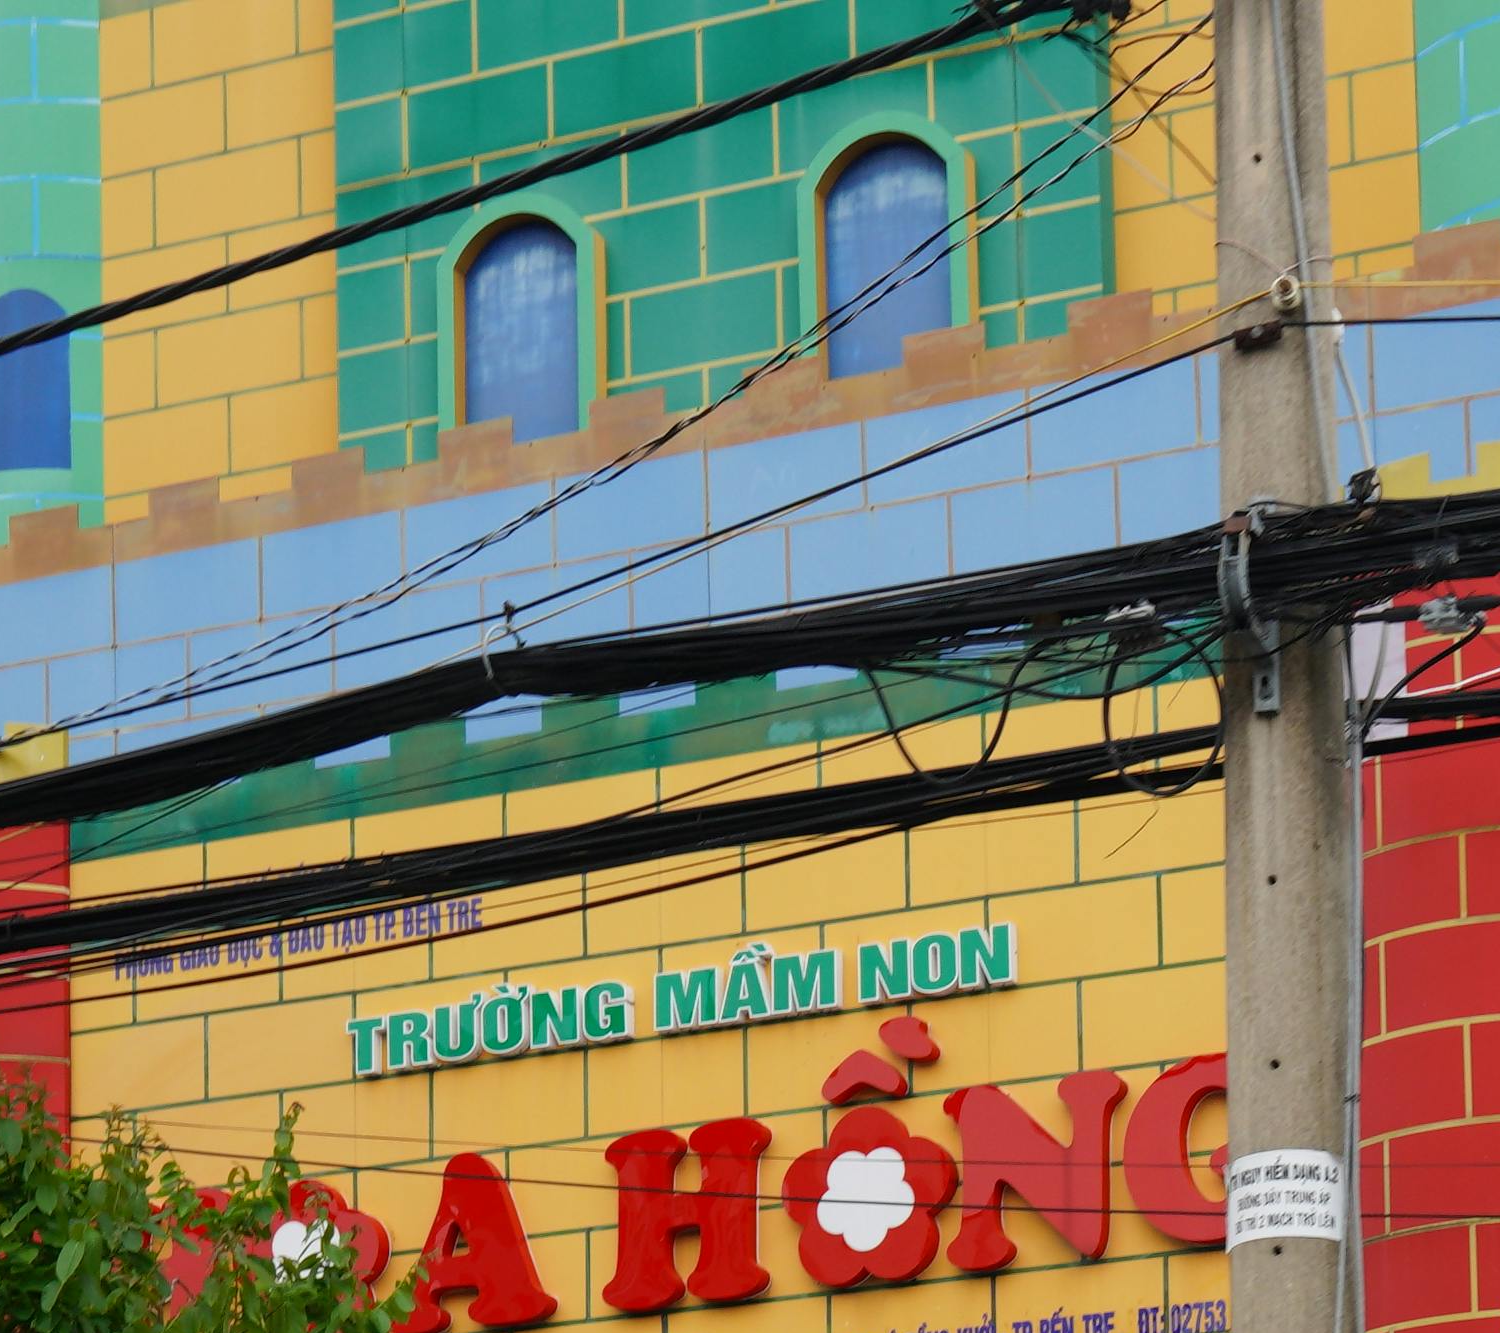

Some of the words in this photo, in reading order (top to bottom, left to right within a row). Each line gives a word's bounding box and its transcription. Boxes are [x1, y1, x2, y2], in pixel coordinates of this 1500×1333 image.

[446, 897, 483, 930] TRE
[345, 979, 634, 1080] TRƯỜNG
[653, 943, 839, 1036] MẦM
[858, 921, 1019, 1006] NON
[1170, 1301, 1226, 1333] 02753
